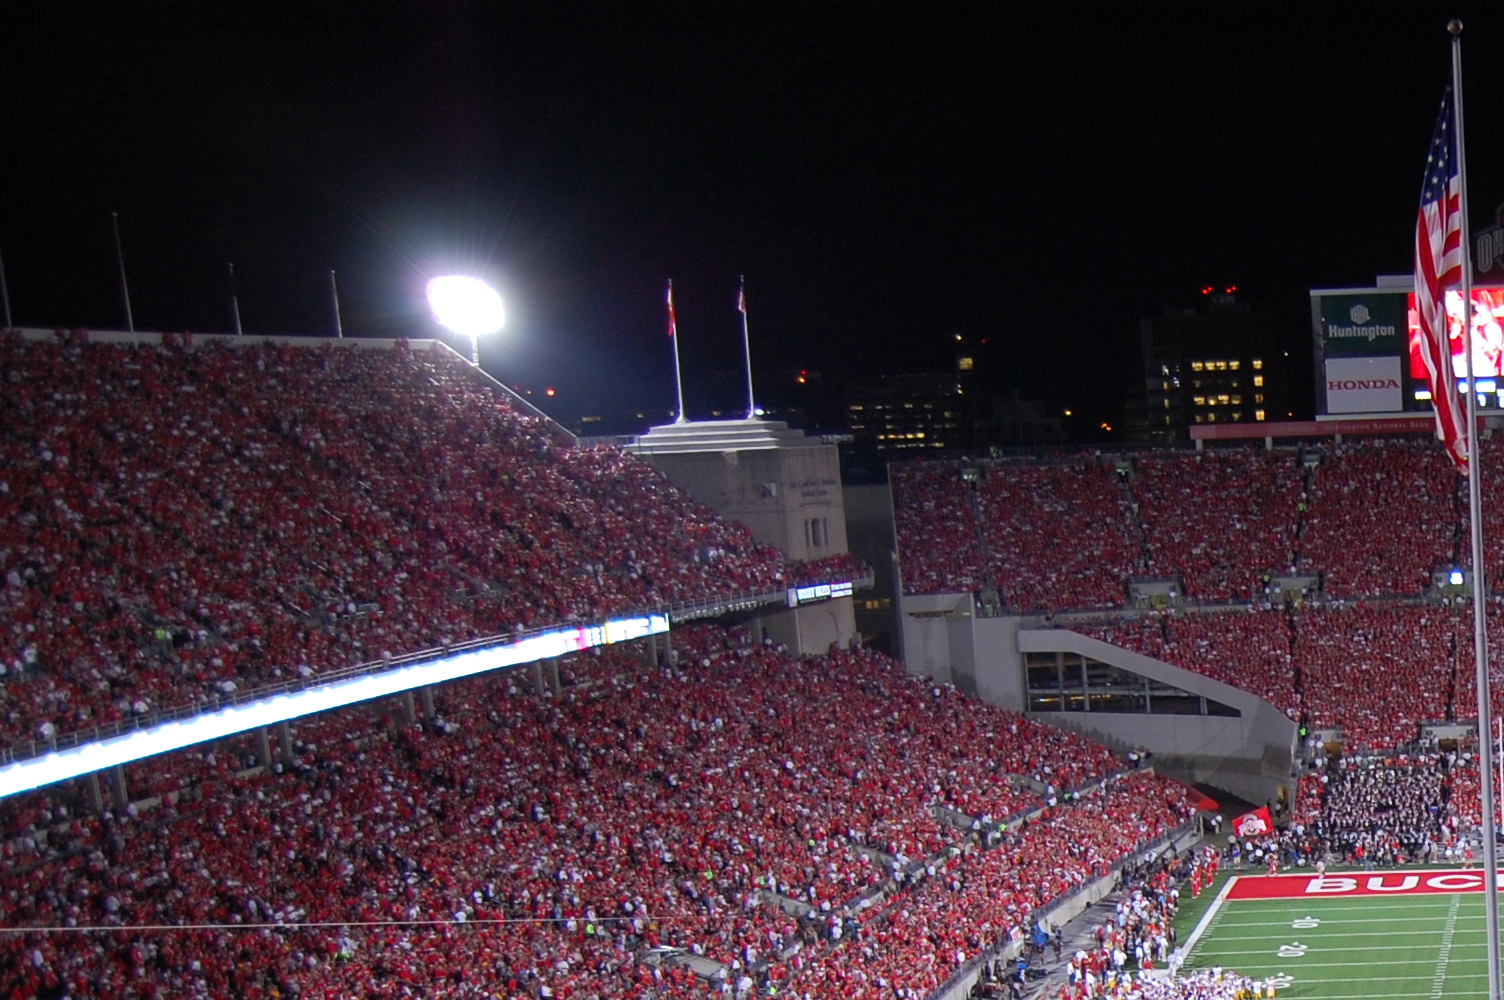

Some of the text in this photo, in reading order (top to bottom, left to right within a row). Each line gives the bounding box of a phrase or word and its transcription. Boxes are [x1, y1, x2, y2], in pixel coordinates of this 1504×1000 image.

[1328, 325, 1395, 341] Huntington
[1328, 379, 1400, 391] HONDA
[1291, 919, 1321, 929] 10
[1277, 945, 1308, 957] 20
